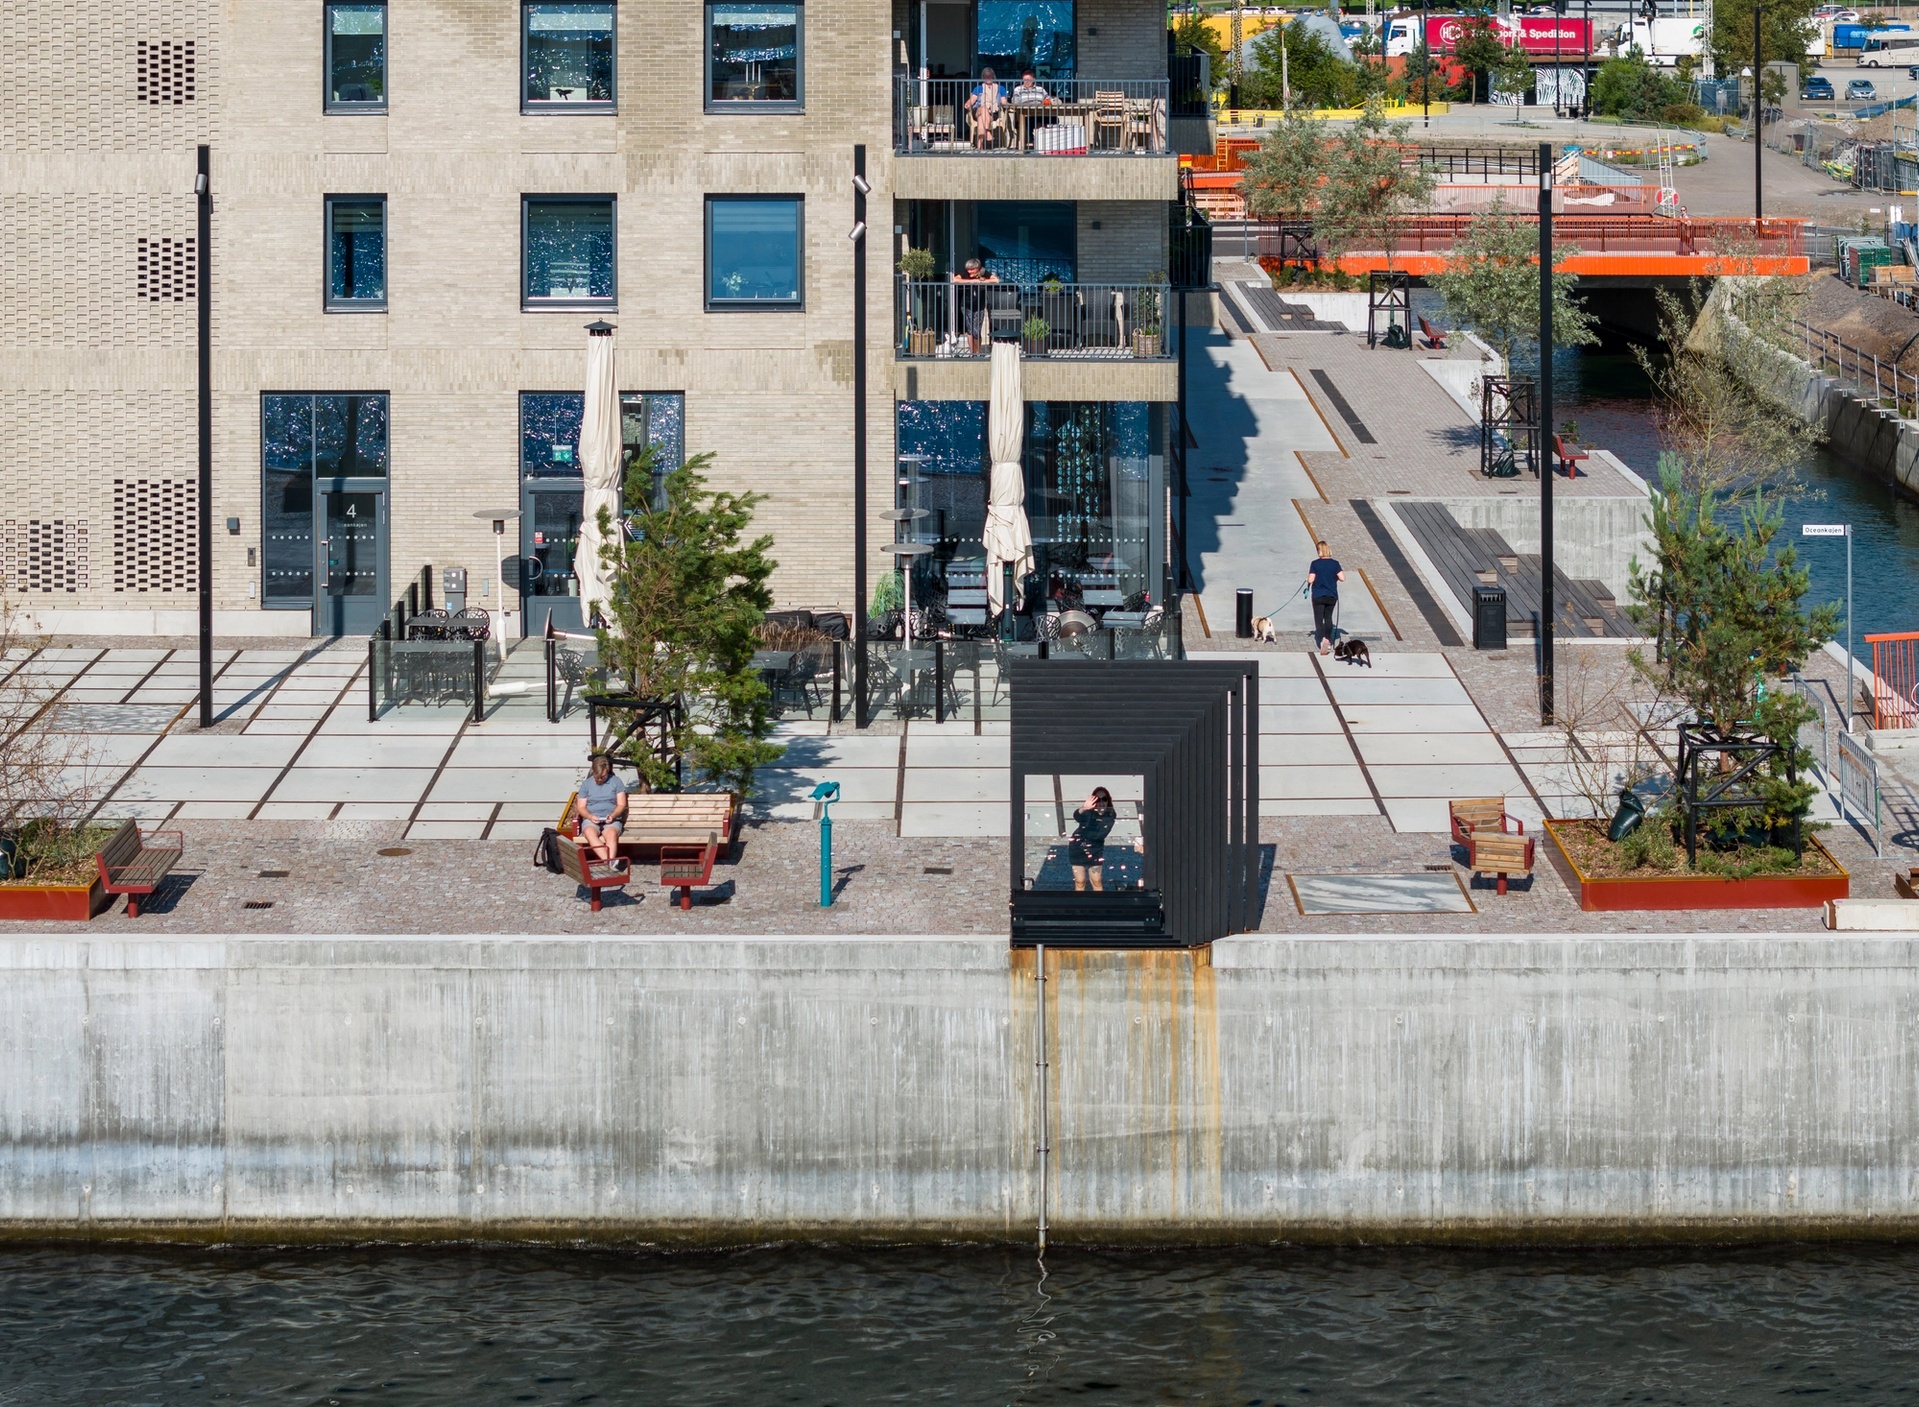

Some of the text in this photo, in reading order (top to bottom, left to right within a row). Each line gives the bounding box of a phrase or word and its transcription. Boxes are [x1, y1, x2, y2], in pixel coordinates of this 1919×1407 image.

[1520, 28, 1527, 38] &
[1529, 28, 1576, 39] Spedition
[346, 503, 357, 519] 4
